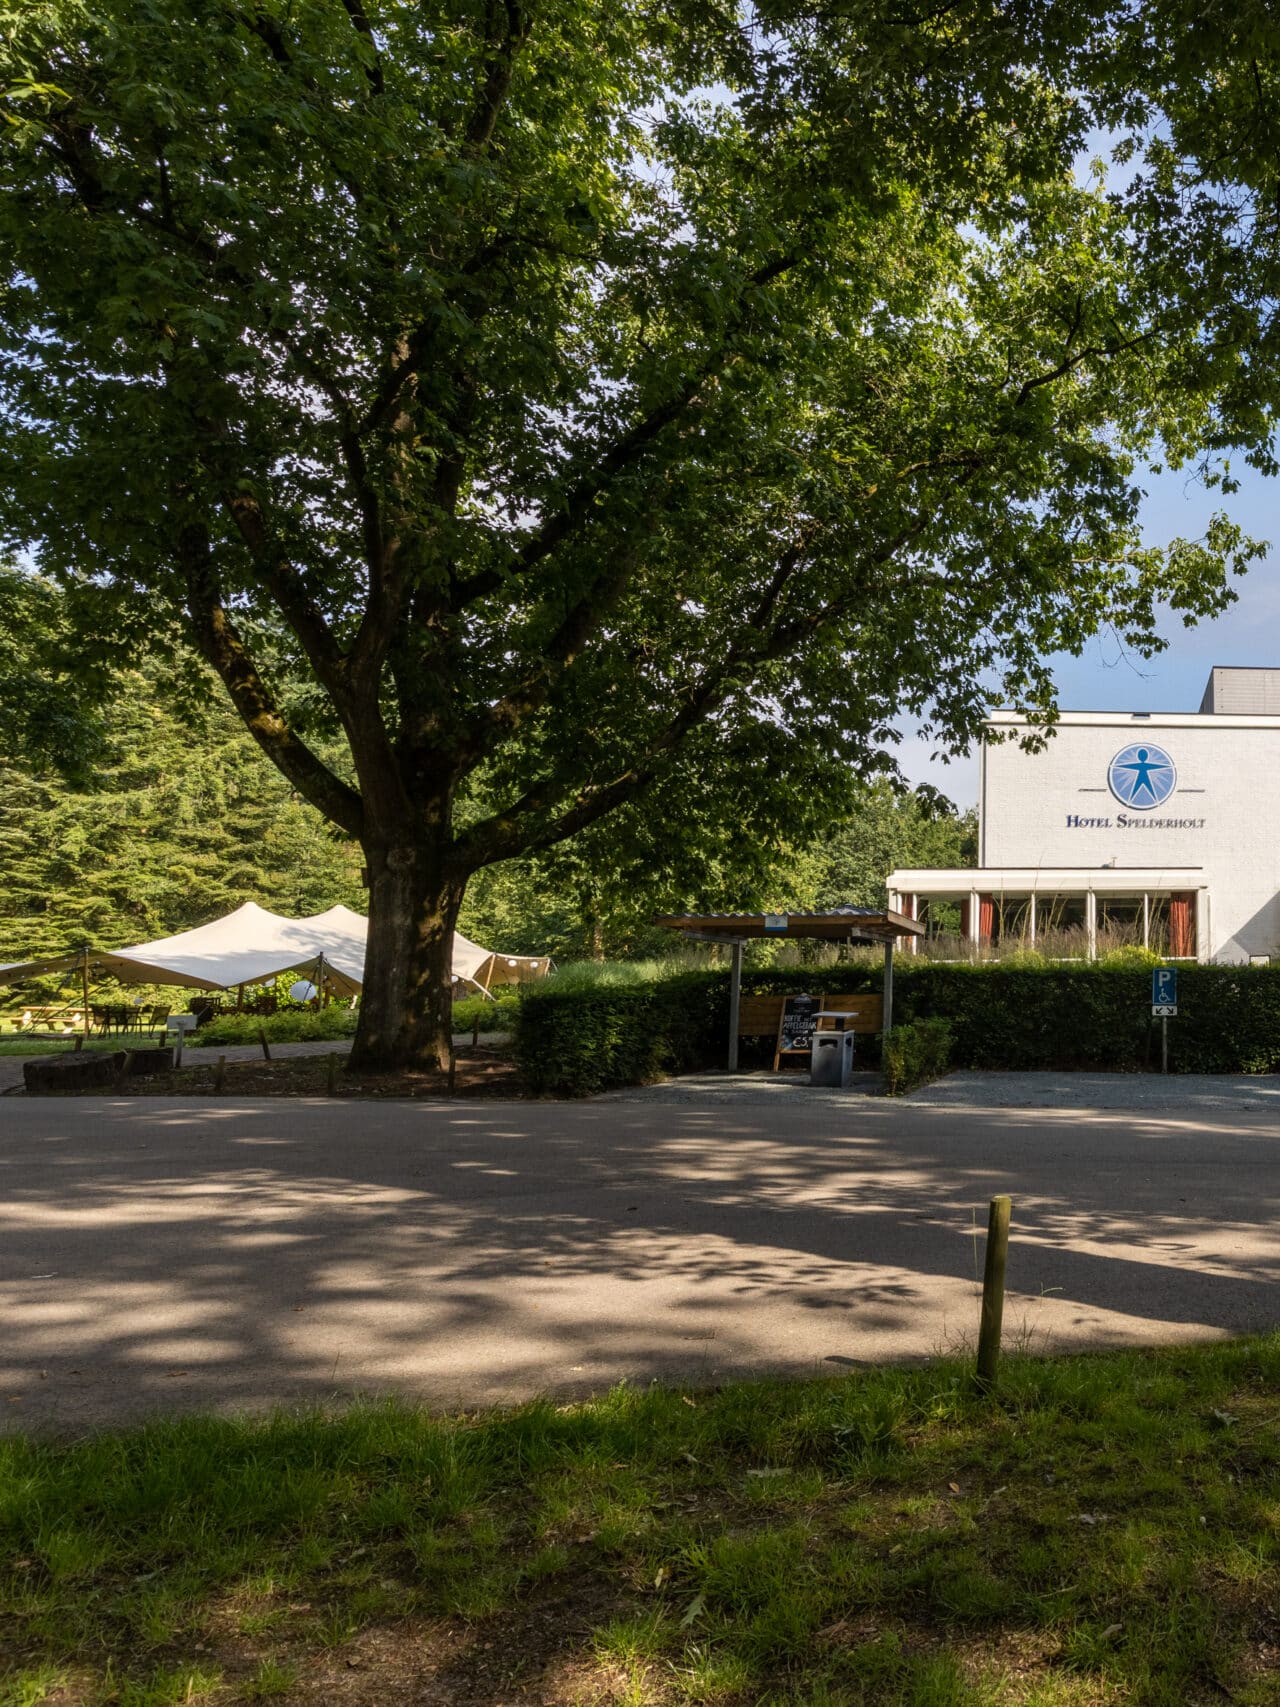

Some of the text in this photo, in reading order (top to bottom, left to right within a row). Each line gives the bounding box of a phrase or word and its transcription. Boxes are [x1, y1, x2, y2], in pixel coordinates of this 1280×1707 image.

[1065, 813, 1206, 828] HOTEL SPELDERHOLT
[1158, 971, 1171, 987] P
